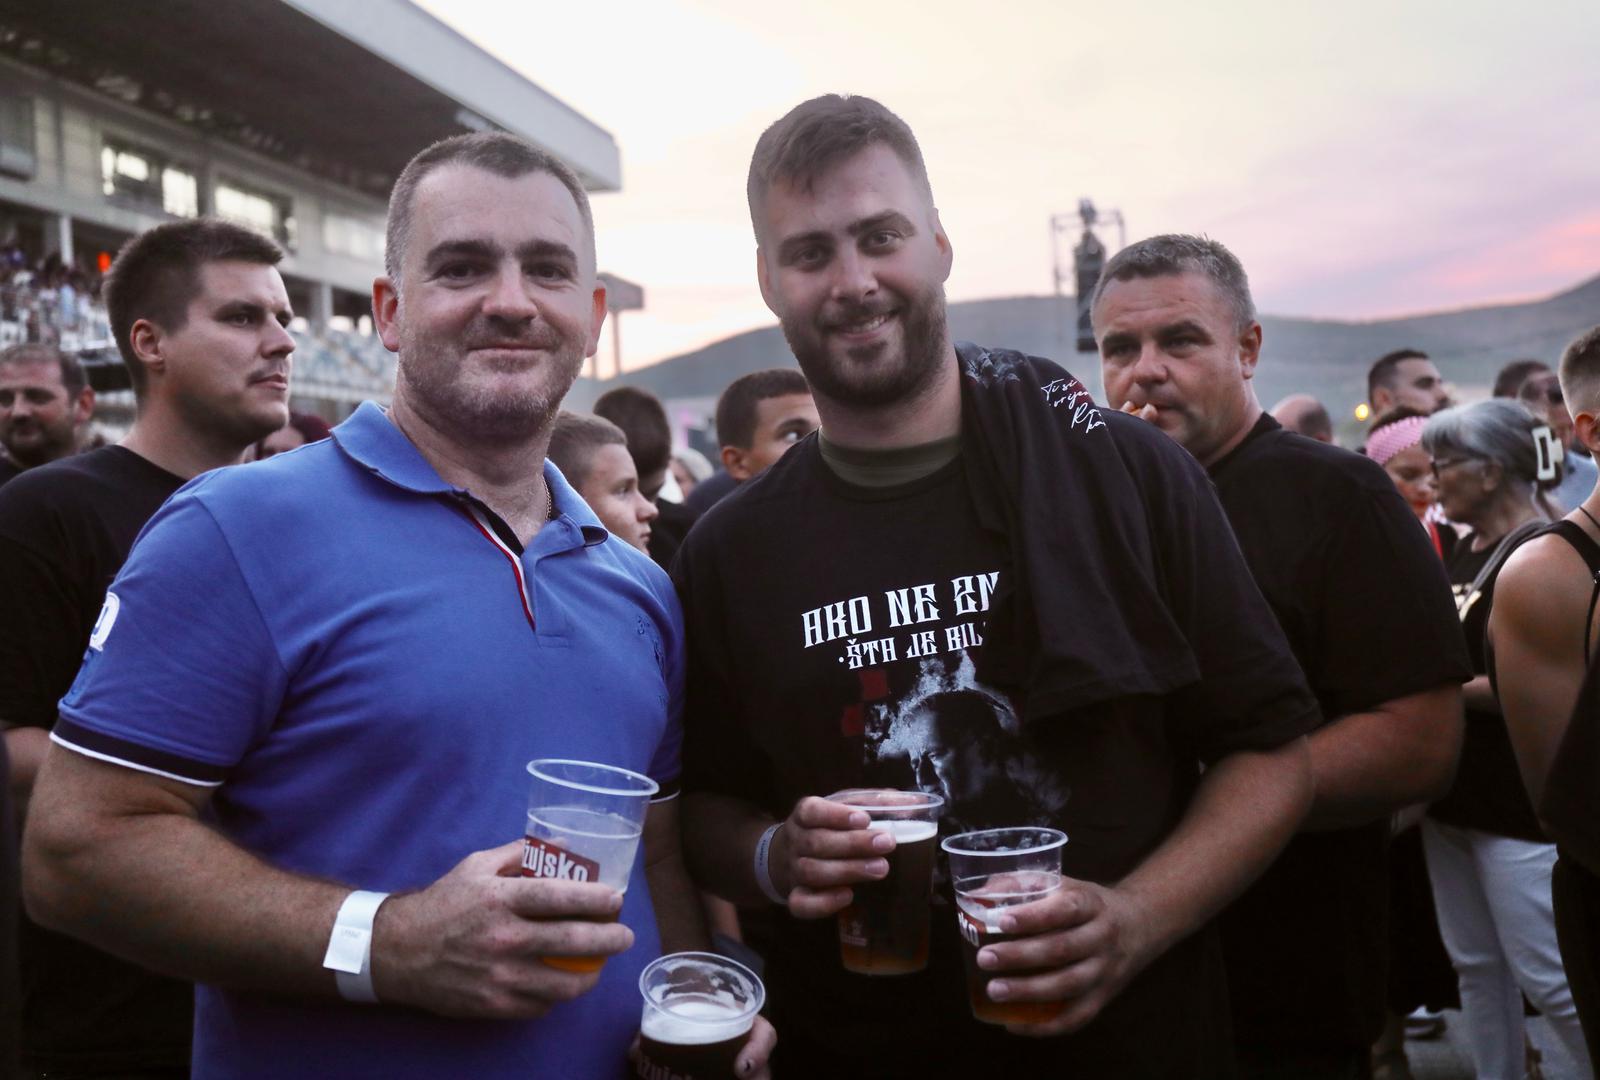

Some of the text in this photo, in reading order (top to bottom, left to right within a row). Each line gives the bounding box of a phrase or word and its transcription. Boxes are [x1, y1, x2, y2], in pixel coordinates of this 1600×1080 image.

[1041, 379, 1064, 401] Ti
[801, 596, 872, 648] AKO
[885, 584, 940, 627] NE
[906, 630, 938, 659] JE
[944, 622, 985, 652] BIL
[522, 840, 589, 882] žujsko
